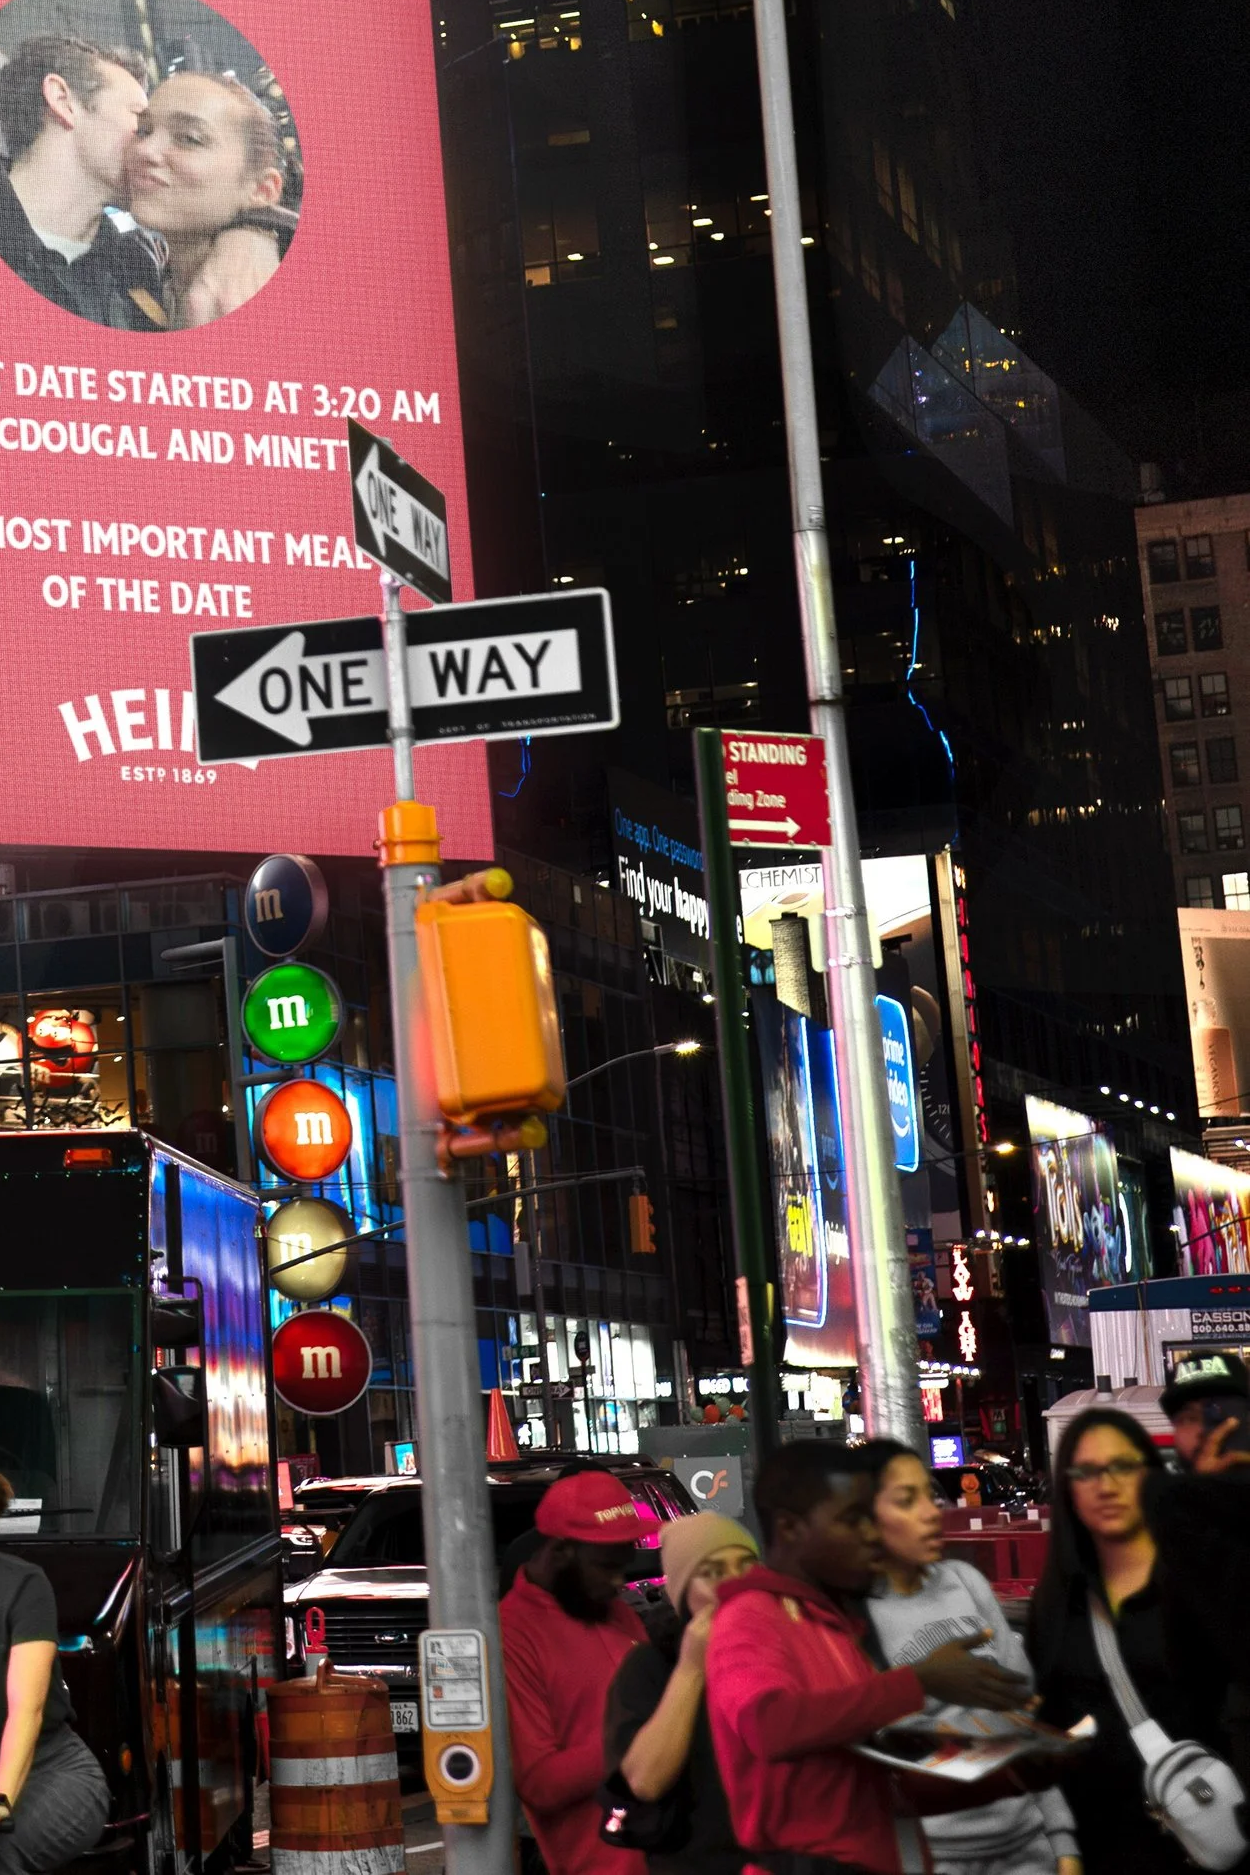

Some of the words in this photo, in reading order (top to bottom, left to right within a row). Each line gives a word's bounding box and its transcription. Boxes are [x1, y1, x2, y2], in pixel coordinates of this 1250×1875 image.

[15, 363, 98, 401] DATE
[107, 370, 253, 411] STARTED
[264, 381, 303, 417] AT
[313, 384, 381, 420] 3:20
[391, 389, 441, 424] AM
[166, 426, 235, 466] AND
[244, 431, 351, 472] MINETT
[368, 470, 399, 535] ONE
[411, 503, 441, 568] WAY
[82, 521, 273, 565] IMPORTANT
[284, 534, 373, 570] MEAL
[42, 575, 89, 610] OF
[97, 578, 161, 614] THE
[170, 582, 253, 618] DATE
[258, 657, 373, 715] ONE
[429, 639, 553, 699] WAY
[58, 687, 258, 770] HEI
[728, 741, 808, 766] STANDING
[172, 766, 218, 785] 1869
[727, 787, 755, 811] ding
[756, 790, 787, 809] Zone
[615, 807, 633, 841] One
[653, 824, 669, 857] One
[670, 838, 706, 873] passwor
[254, 887, 285, 923] m
[618, 854, 646, 904] Find
[646, 875, 673, 918] your
[673, 876, 710, 940] happy
[267, 993, 309, 1030] m
[882, 1030, 905, 1067] prime
[295, 1111, 334, 1146] m
[279, 1231, 314, 1266] m
[300, 1345, 343, 1381] m
[390, 1710, 414, 1725] 1862
